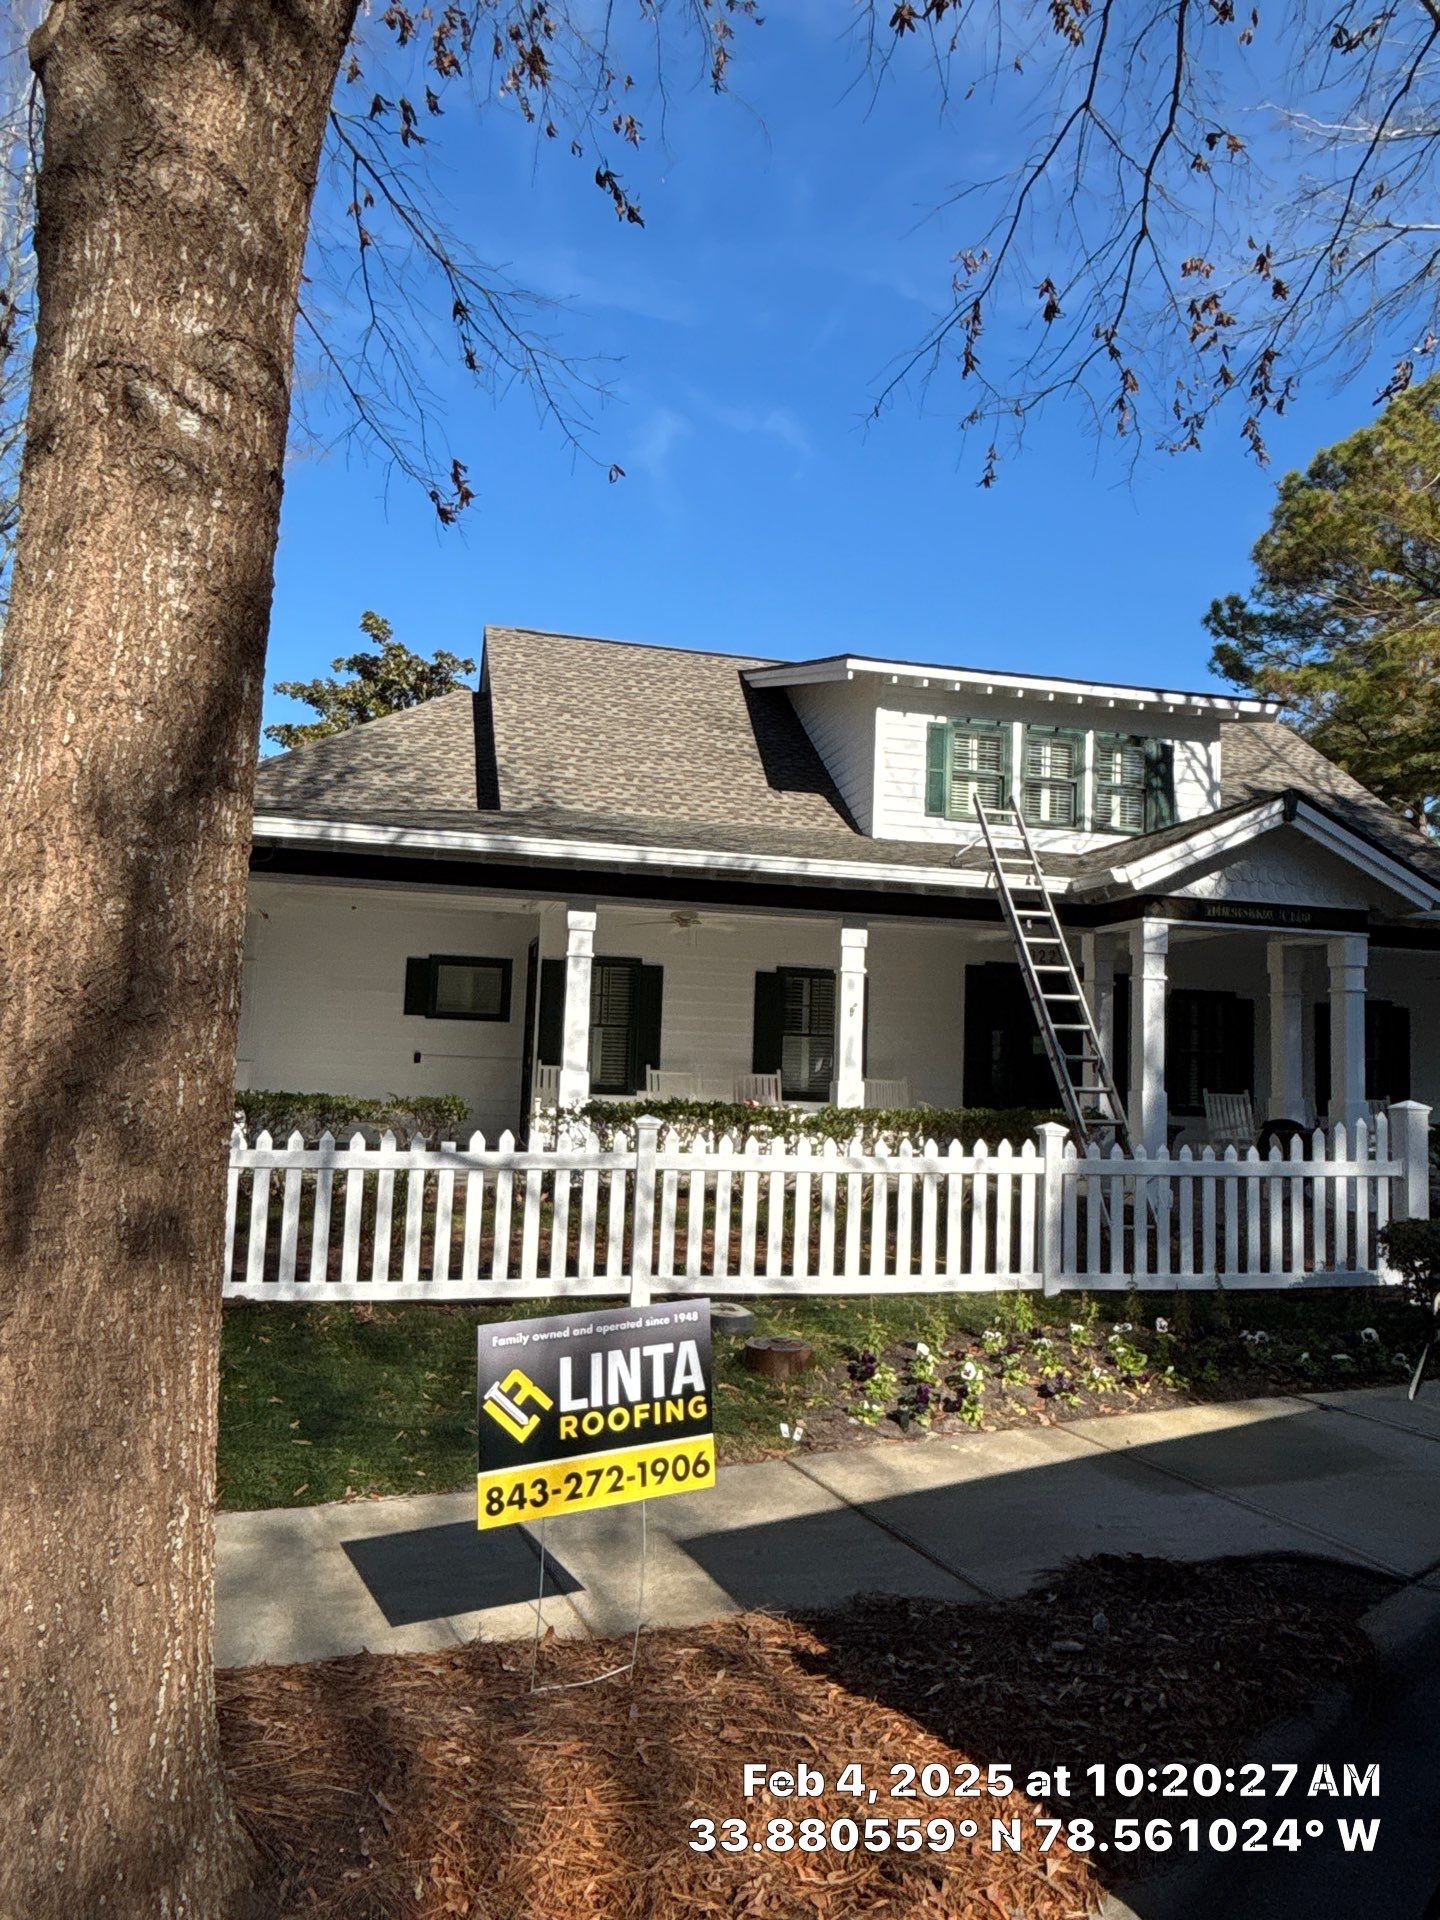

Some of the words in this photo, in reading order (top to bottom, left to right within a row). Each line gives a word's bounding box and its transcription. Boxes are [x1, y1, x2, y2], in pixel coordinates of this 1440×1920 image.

[492, 1332, 530, 1347] Family
[532, 1326, 570, 1342] owned
[572, 1324, 593, 1337] and
[596, 1317, 643, 1335] operated
[645, 1316, 670, 1327] since
[673, 1311, 699, 1323] 1948
[559, 1339, 706, 1413] LINTA
[559, 1395, 707, 1440] ROOFING
[485, 1451, 711, 1517] 843-272-1906
